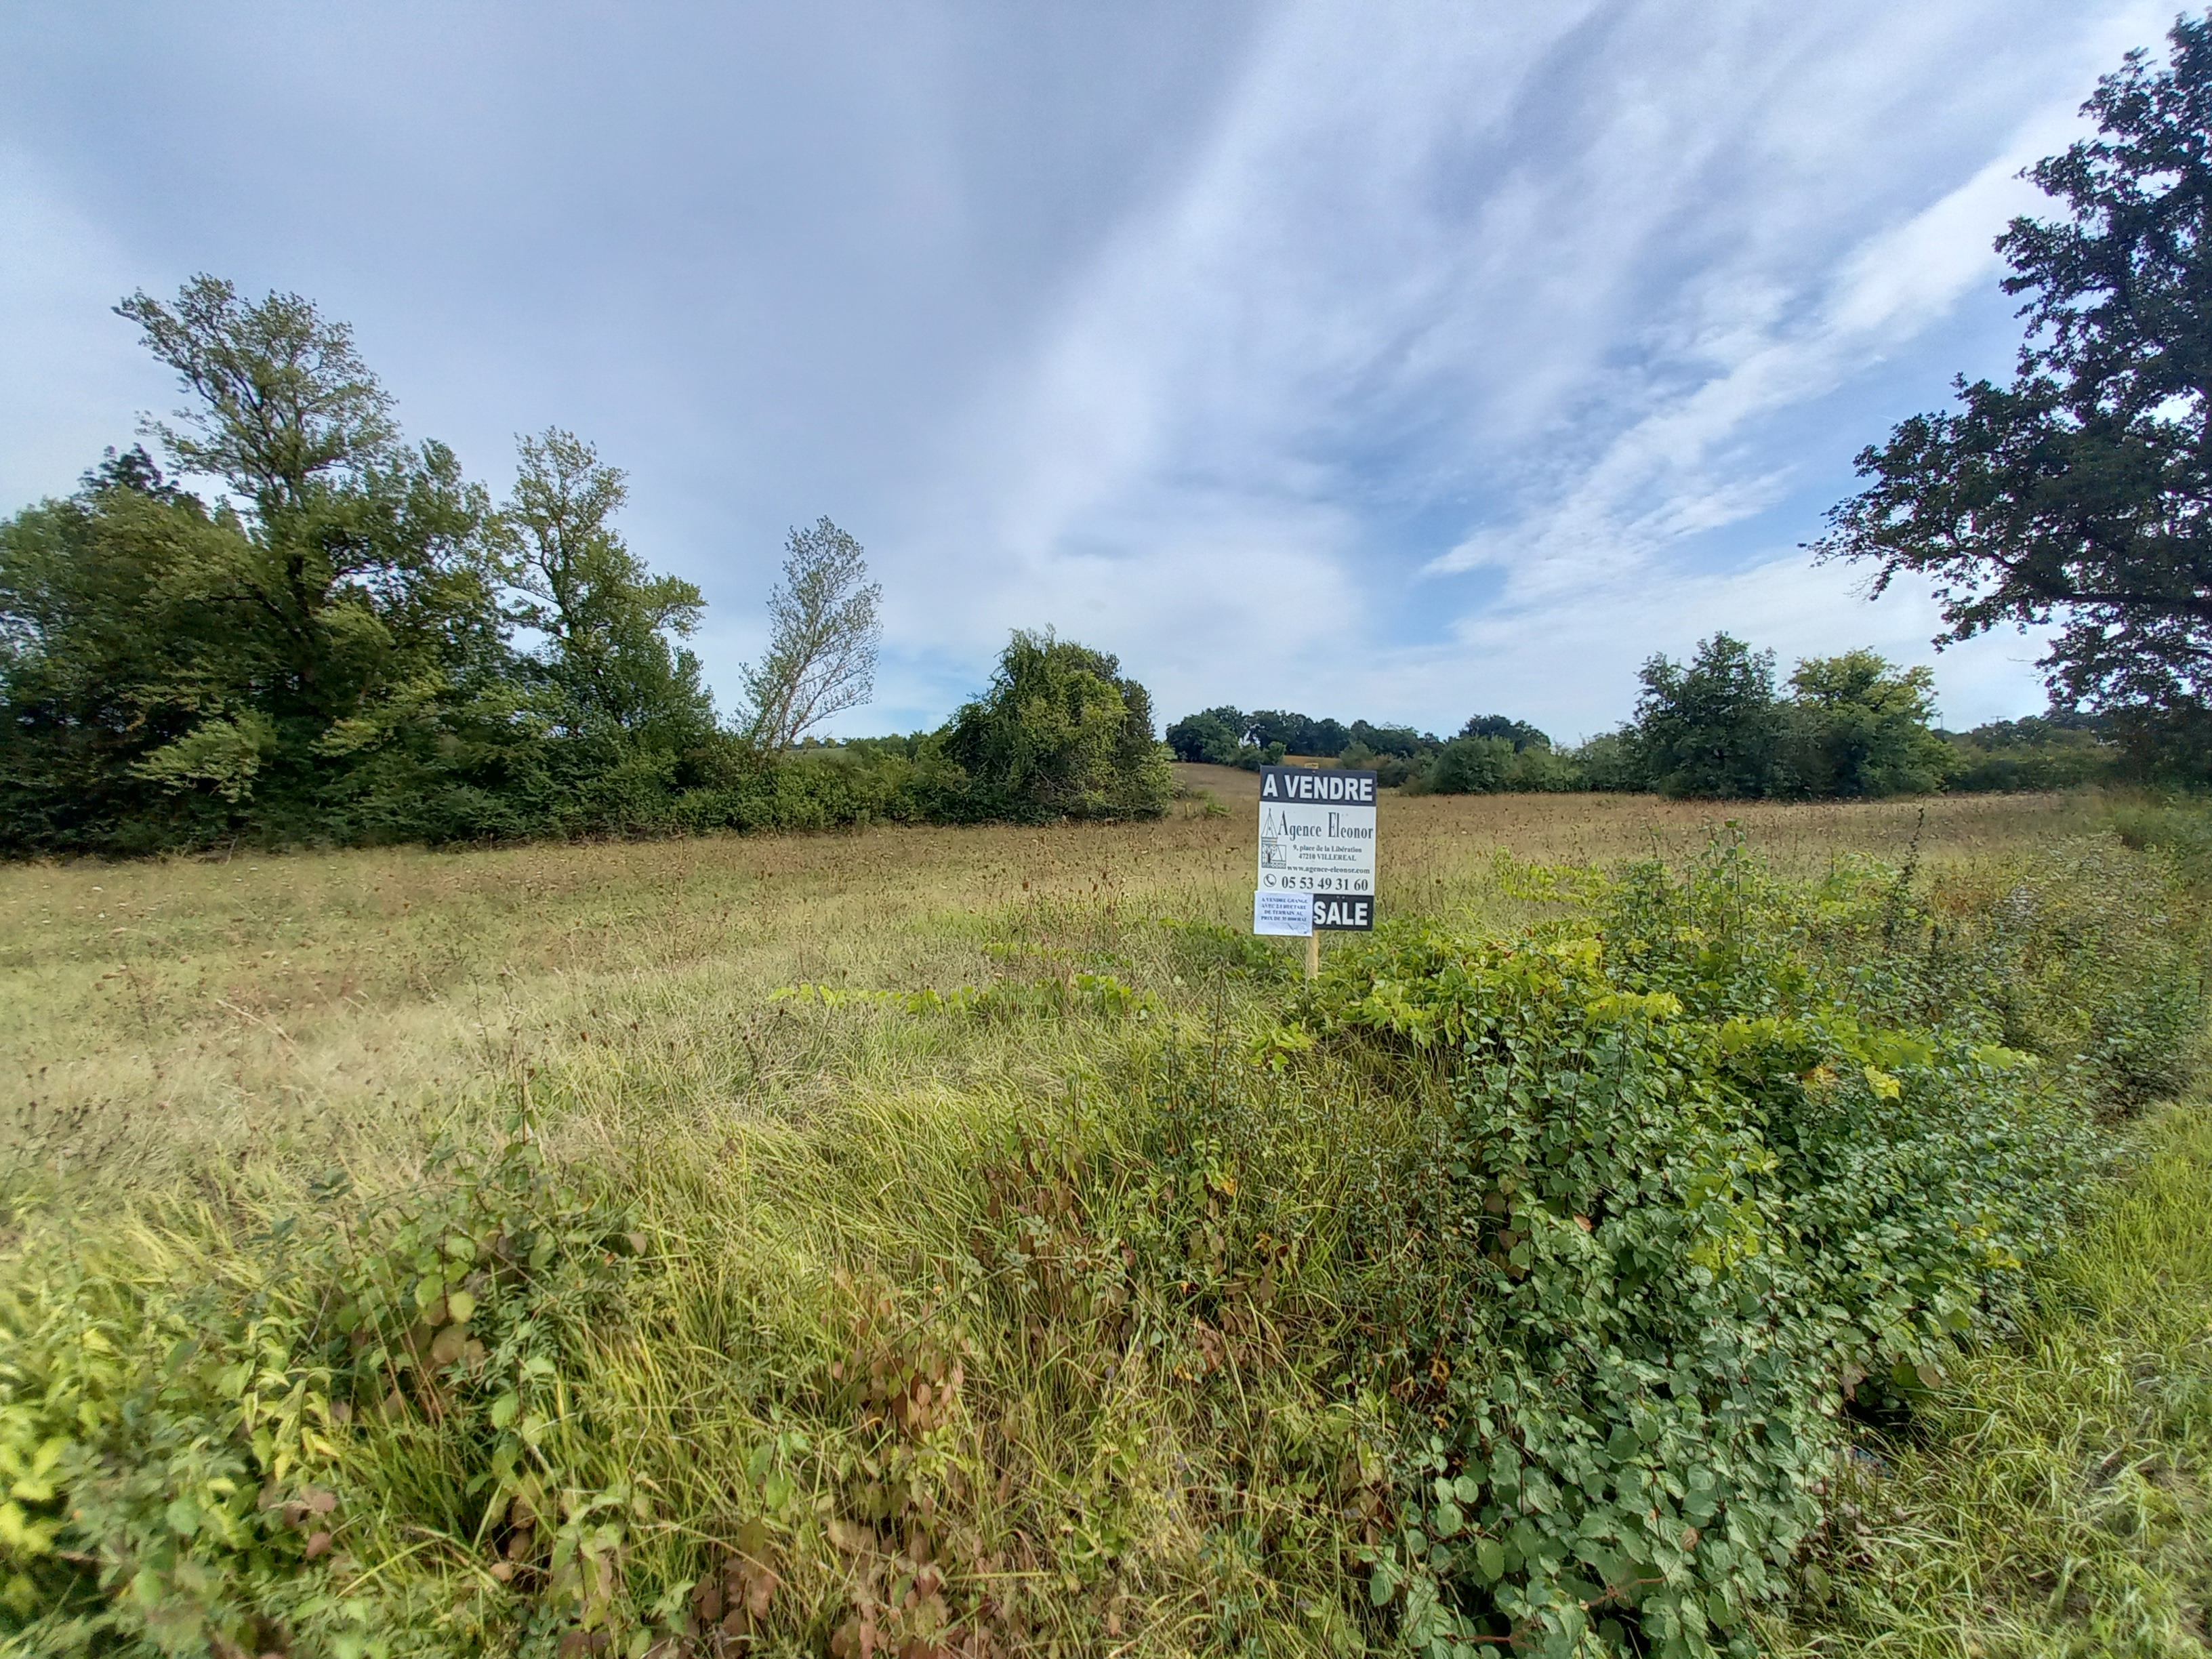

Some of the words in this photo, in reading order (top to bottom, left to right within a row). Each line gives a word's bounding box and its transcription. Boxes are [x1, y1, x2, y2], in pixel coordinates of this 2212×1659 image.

[1263, 774, 1278, 797] A
[1284, 775, 1373, 801] VENDRE
[1277, 811, 1322, 841] Agence
[1328, 812, 1374, 839] Eleonor
[1288, 865, 1370, 874] www.agence-eleonor.com
[1282, 876, 1296, 888] 05
[1300, 877, 1313, 889] 53
[1317, 877, 1332, 890] 49
[1335, 878, 1349, 890] 31
[1354, 878, 1368, 891] 60
[1313, 901, 1368, 926] SALE
